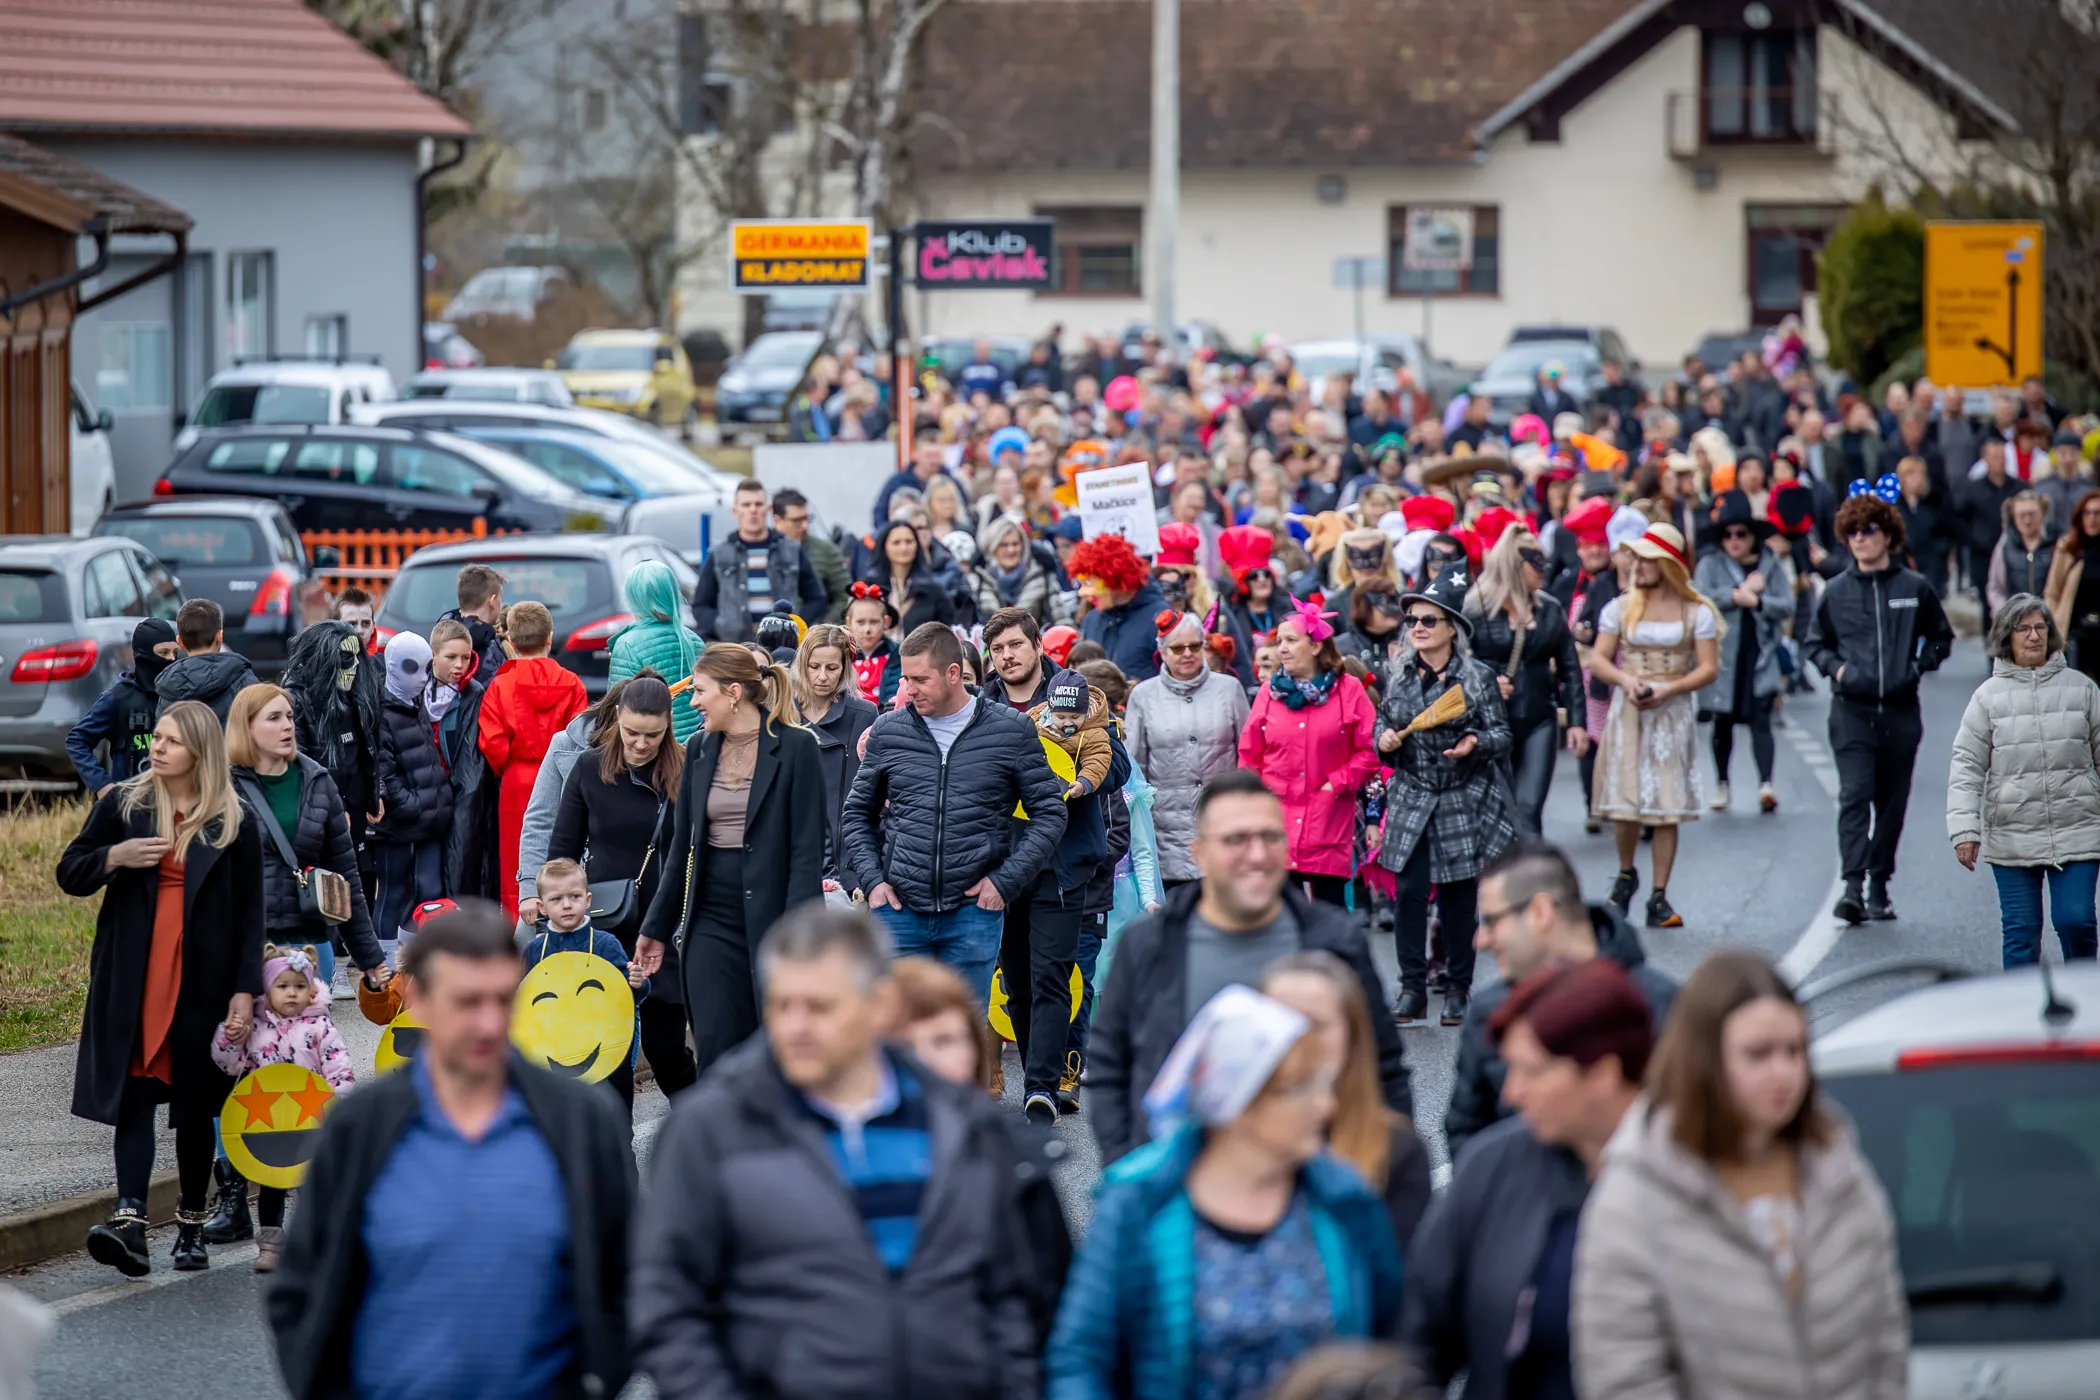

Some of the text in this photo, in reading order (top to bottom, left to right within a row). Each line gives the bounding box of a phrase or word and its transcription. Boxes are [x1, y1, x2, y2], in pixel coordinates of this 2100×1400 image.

[741, 233, 862, 250] GERMANIA
[947, 230, 1026, 253] Klub
[1055, 685, 1079, 697] MICKEY
[1054, 697, 1077, 708] MOUSE
